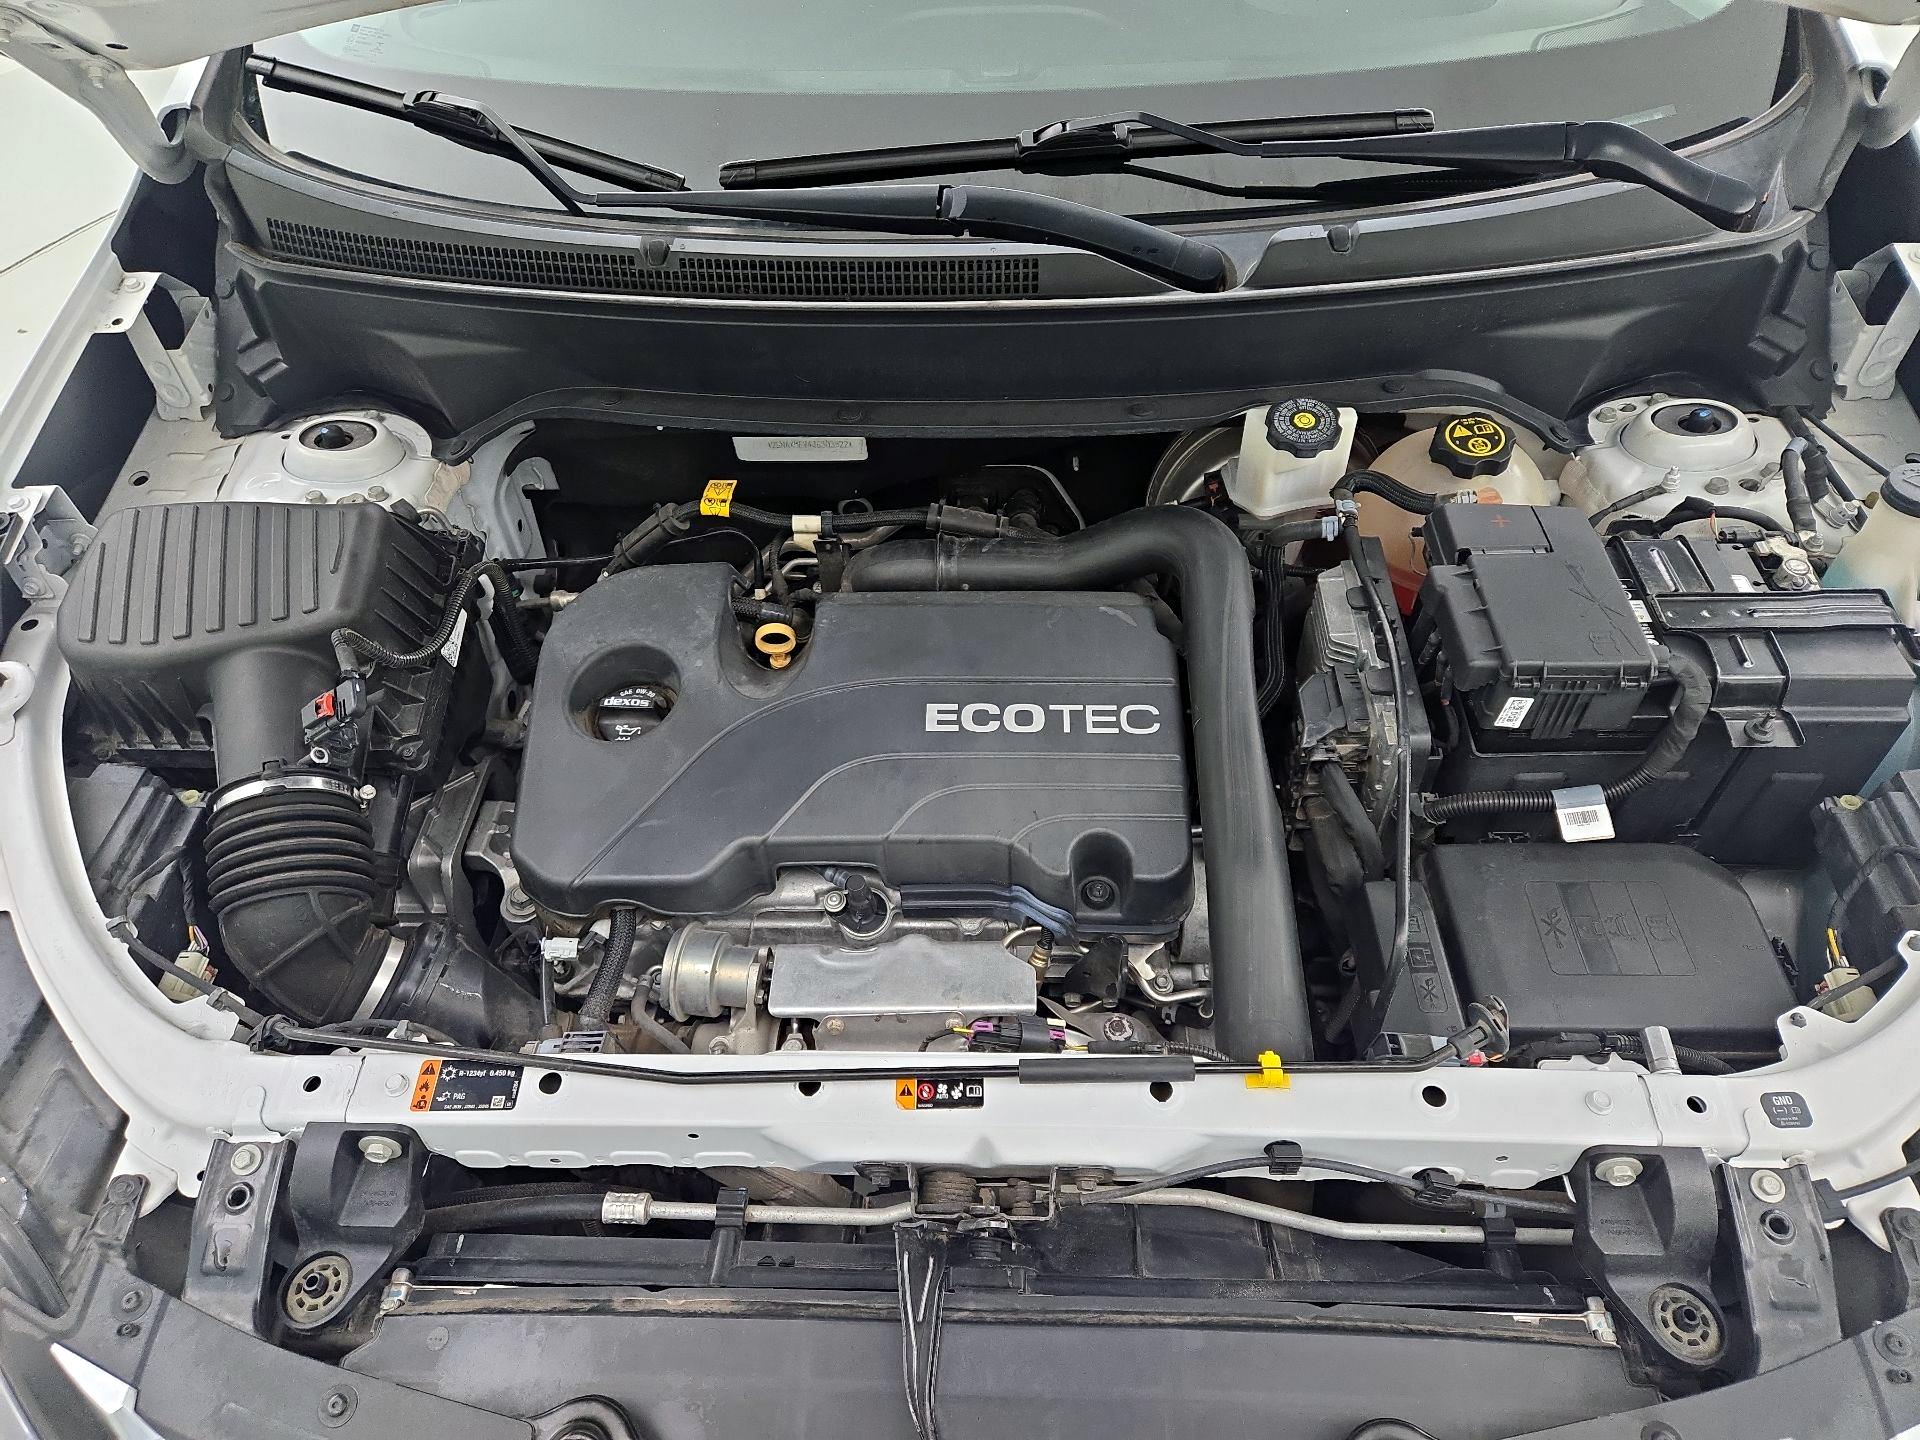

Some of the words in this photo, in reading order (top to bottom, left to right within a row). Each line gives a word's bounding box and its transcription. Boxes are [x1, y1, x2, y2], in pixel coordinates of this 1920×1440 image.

[620, 688, 633, 696] SAE
[635, 688, 656, 698] 0W-20
[603, 696, 651, 706] dexos
[925, 703, 1161, 735] ECOTEC
[458, 1070, 487, 1078] R-1234yf
[507, 1070, 516, 1078] kg
[1772, 1096, 1793, 1105] GND
